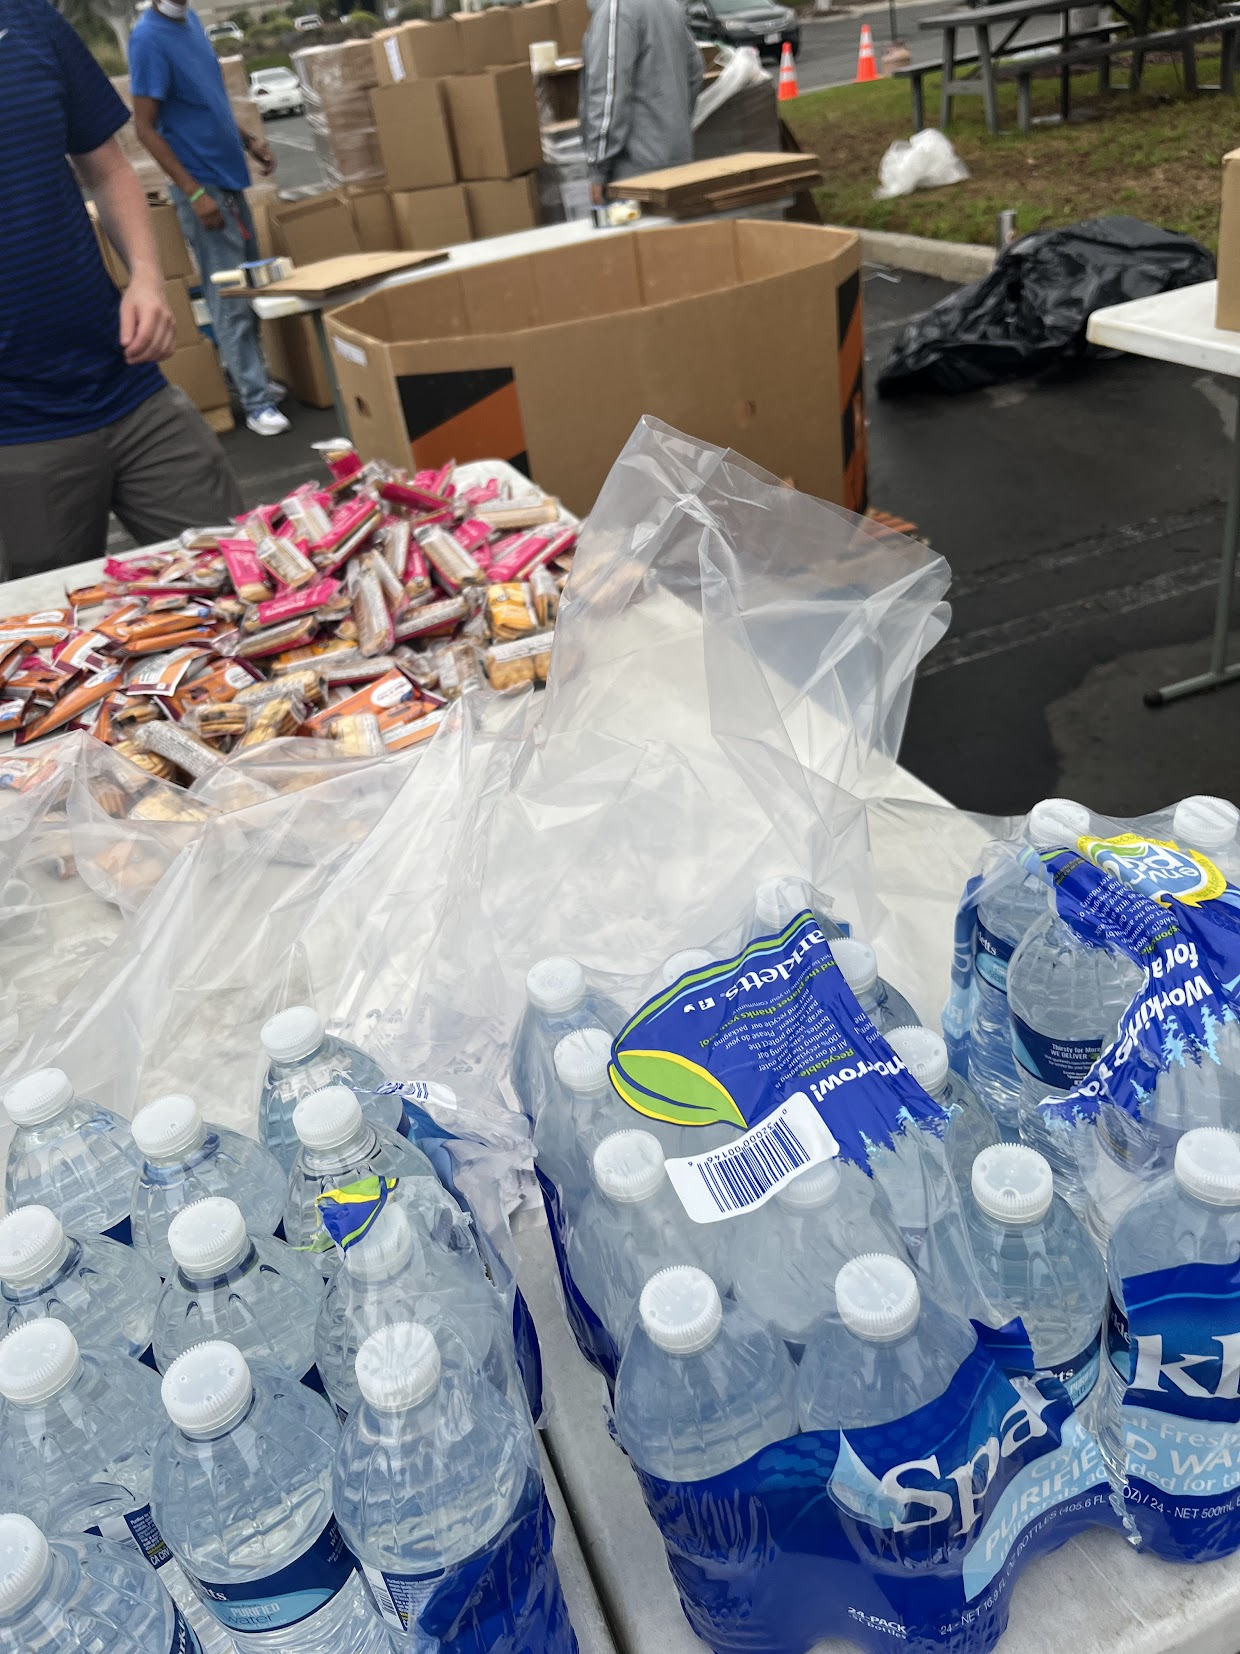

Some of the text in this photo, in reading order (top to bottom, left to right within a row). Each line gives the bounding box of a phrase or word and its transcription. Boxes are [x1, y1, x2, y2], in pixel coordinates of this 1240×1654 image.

[1151, 942, 1200, 977] for a
[739, 1006, 777, 1020] thanks
[805, 998, 819, 1015] part
[762, 1010, 787, 1028] recycle
[723, 1035, 741, 1050] your
[749, 1029, 776, 1040] Please
[760, 1031, 786, 1048] protect
[802, 1022, 836, 1048] including
[746, 1042, 762, 1052] the
[836, 1038, 848, 1051] All
[786, 1042, 820, 1069] recyclable
[813, 1047, 828, 1060] our
[779, 1054, 814, 1084] packaging
[741, 1121, 774, 1147] 32000
[705, 1144, 742, 1164] 00146
[961, 1606, 981, 1625] NET
[983, 1589, 999, 1610] 16.9
[1017, 1513, 1058, 1556] BOTTLES
[1092, 1494, 1107, 1506] FL
[1150, 1497, 1164, 1513] 24
[1174, 1507, 1199, 1519] NET
[230, 1602, 280, 1618] PURIFIED
[848, 1606, 907, 1634] 24-PACK
